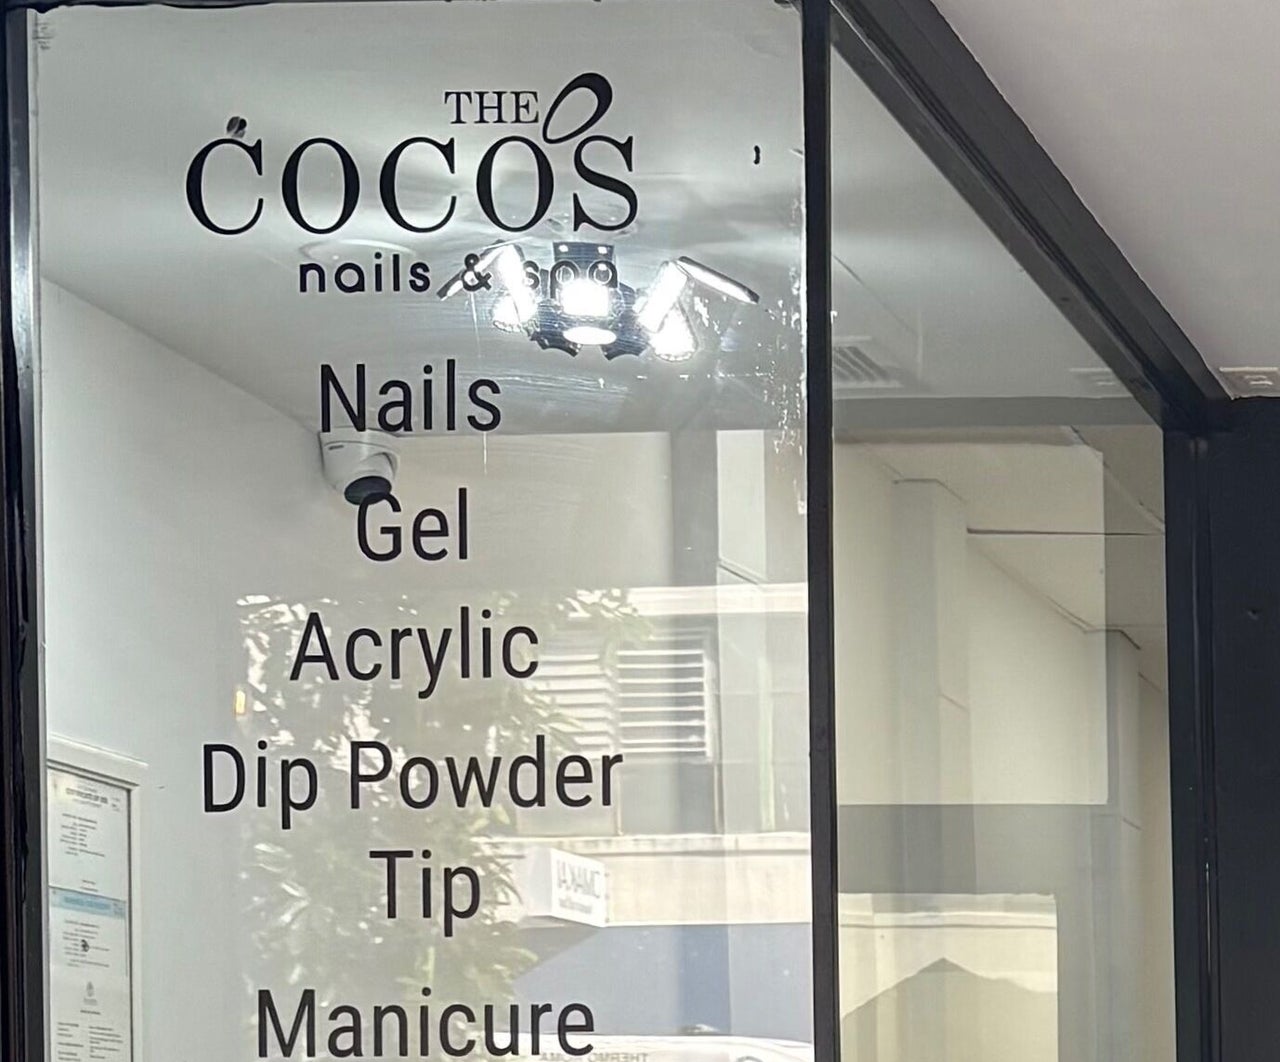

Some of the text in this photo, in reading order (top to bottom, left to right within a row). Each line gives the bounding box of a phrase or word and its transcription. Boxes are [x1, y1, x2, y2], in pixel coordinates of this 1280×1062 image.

[445, 91, 538, 123] THE
[300, 252, 619, 298] nails & spa
[318, 360, 500, 436] Nails
[355, 488, 468, 562] Gel
[290, 608, 537, 698] Acrylic
[204, 735, 622, 829] Dip Powder
[370, 850, 479, 937] Tip
[259, 988, 593, 1057] Manicure
